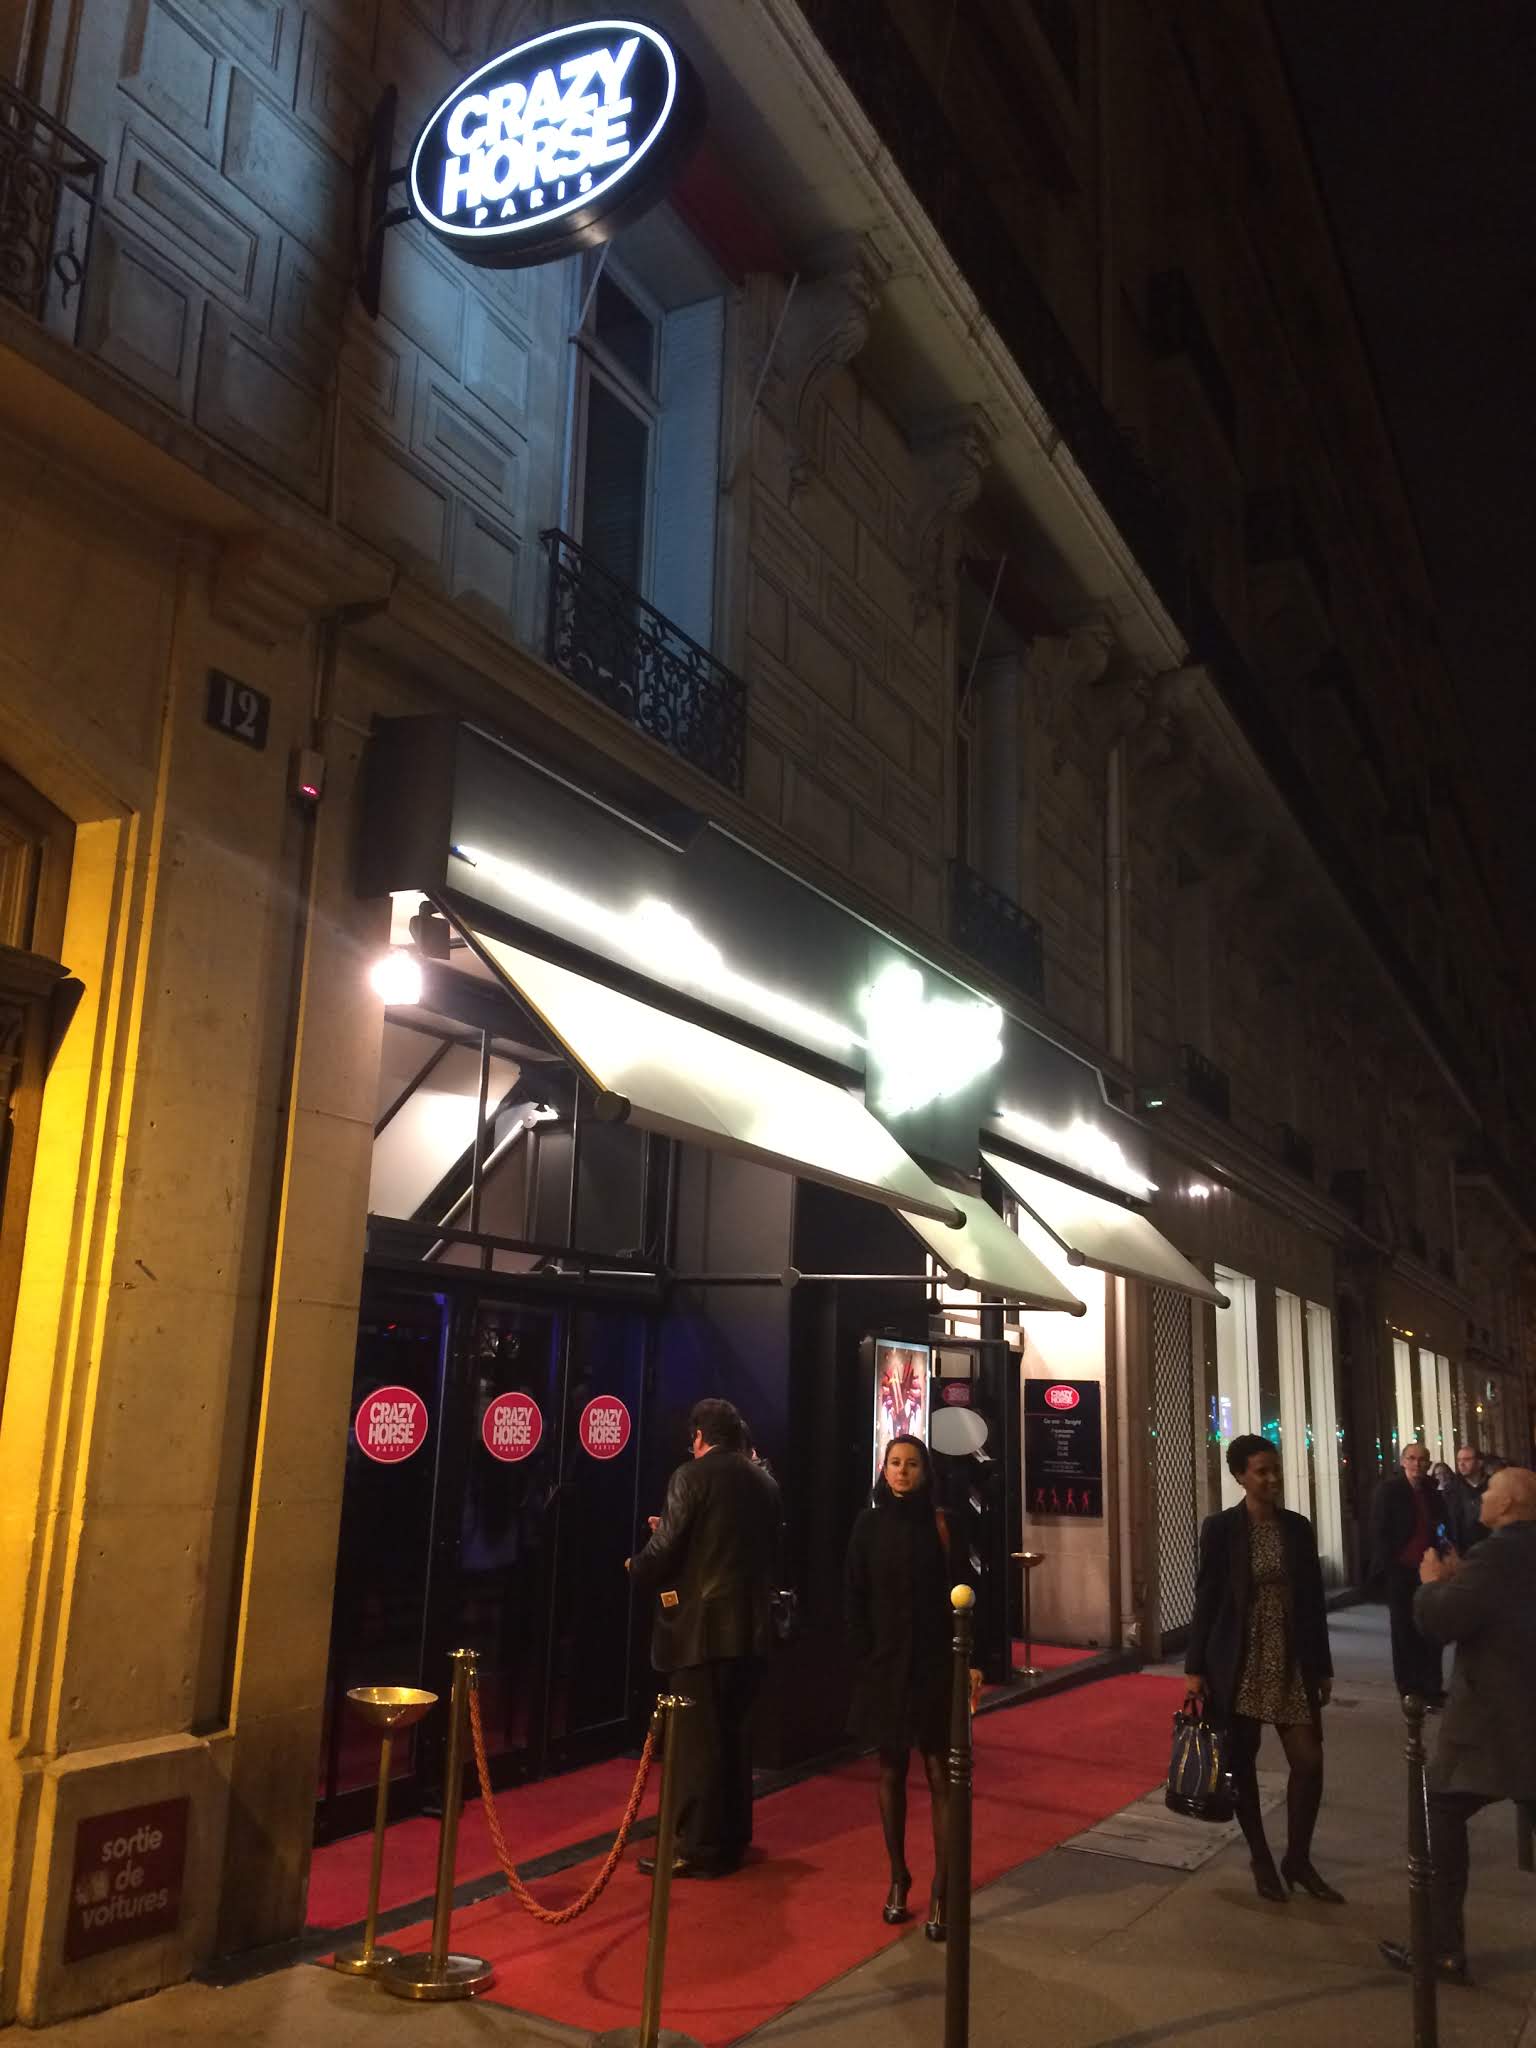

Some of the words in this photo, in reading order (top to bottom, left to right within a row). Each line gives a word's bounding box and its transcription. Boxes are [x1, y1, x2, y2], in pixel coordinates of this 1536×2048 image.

[446, 37, 640, 155] CRAZY
[442, 97, 633, 217] HORSE
[474, 171, 594, 226] PARIS
[220, 681, 258, 738] 12
[369, 1402, 417, 1422] CRAZY
[493, 1406, 534, 1426] CRAZY
[588, 1408, 623, 1426] CRAZY
[367, 1423, 415, 1445] HORSE
[492, 1425, 532, 1445] HORSE
[588, 1426, 622, 1444] HORSE
[102, 1825, 162, 1862] sortie
[115, 1859, 145, 1892] de
[82, 1889, 168, 1928] voitures
